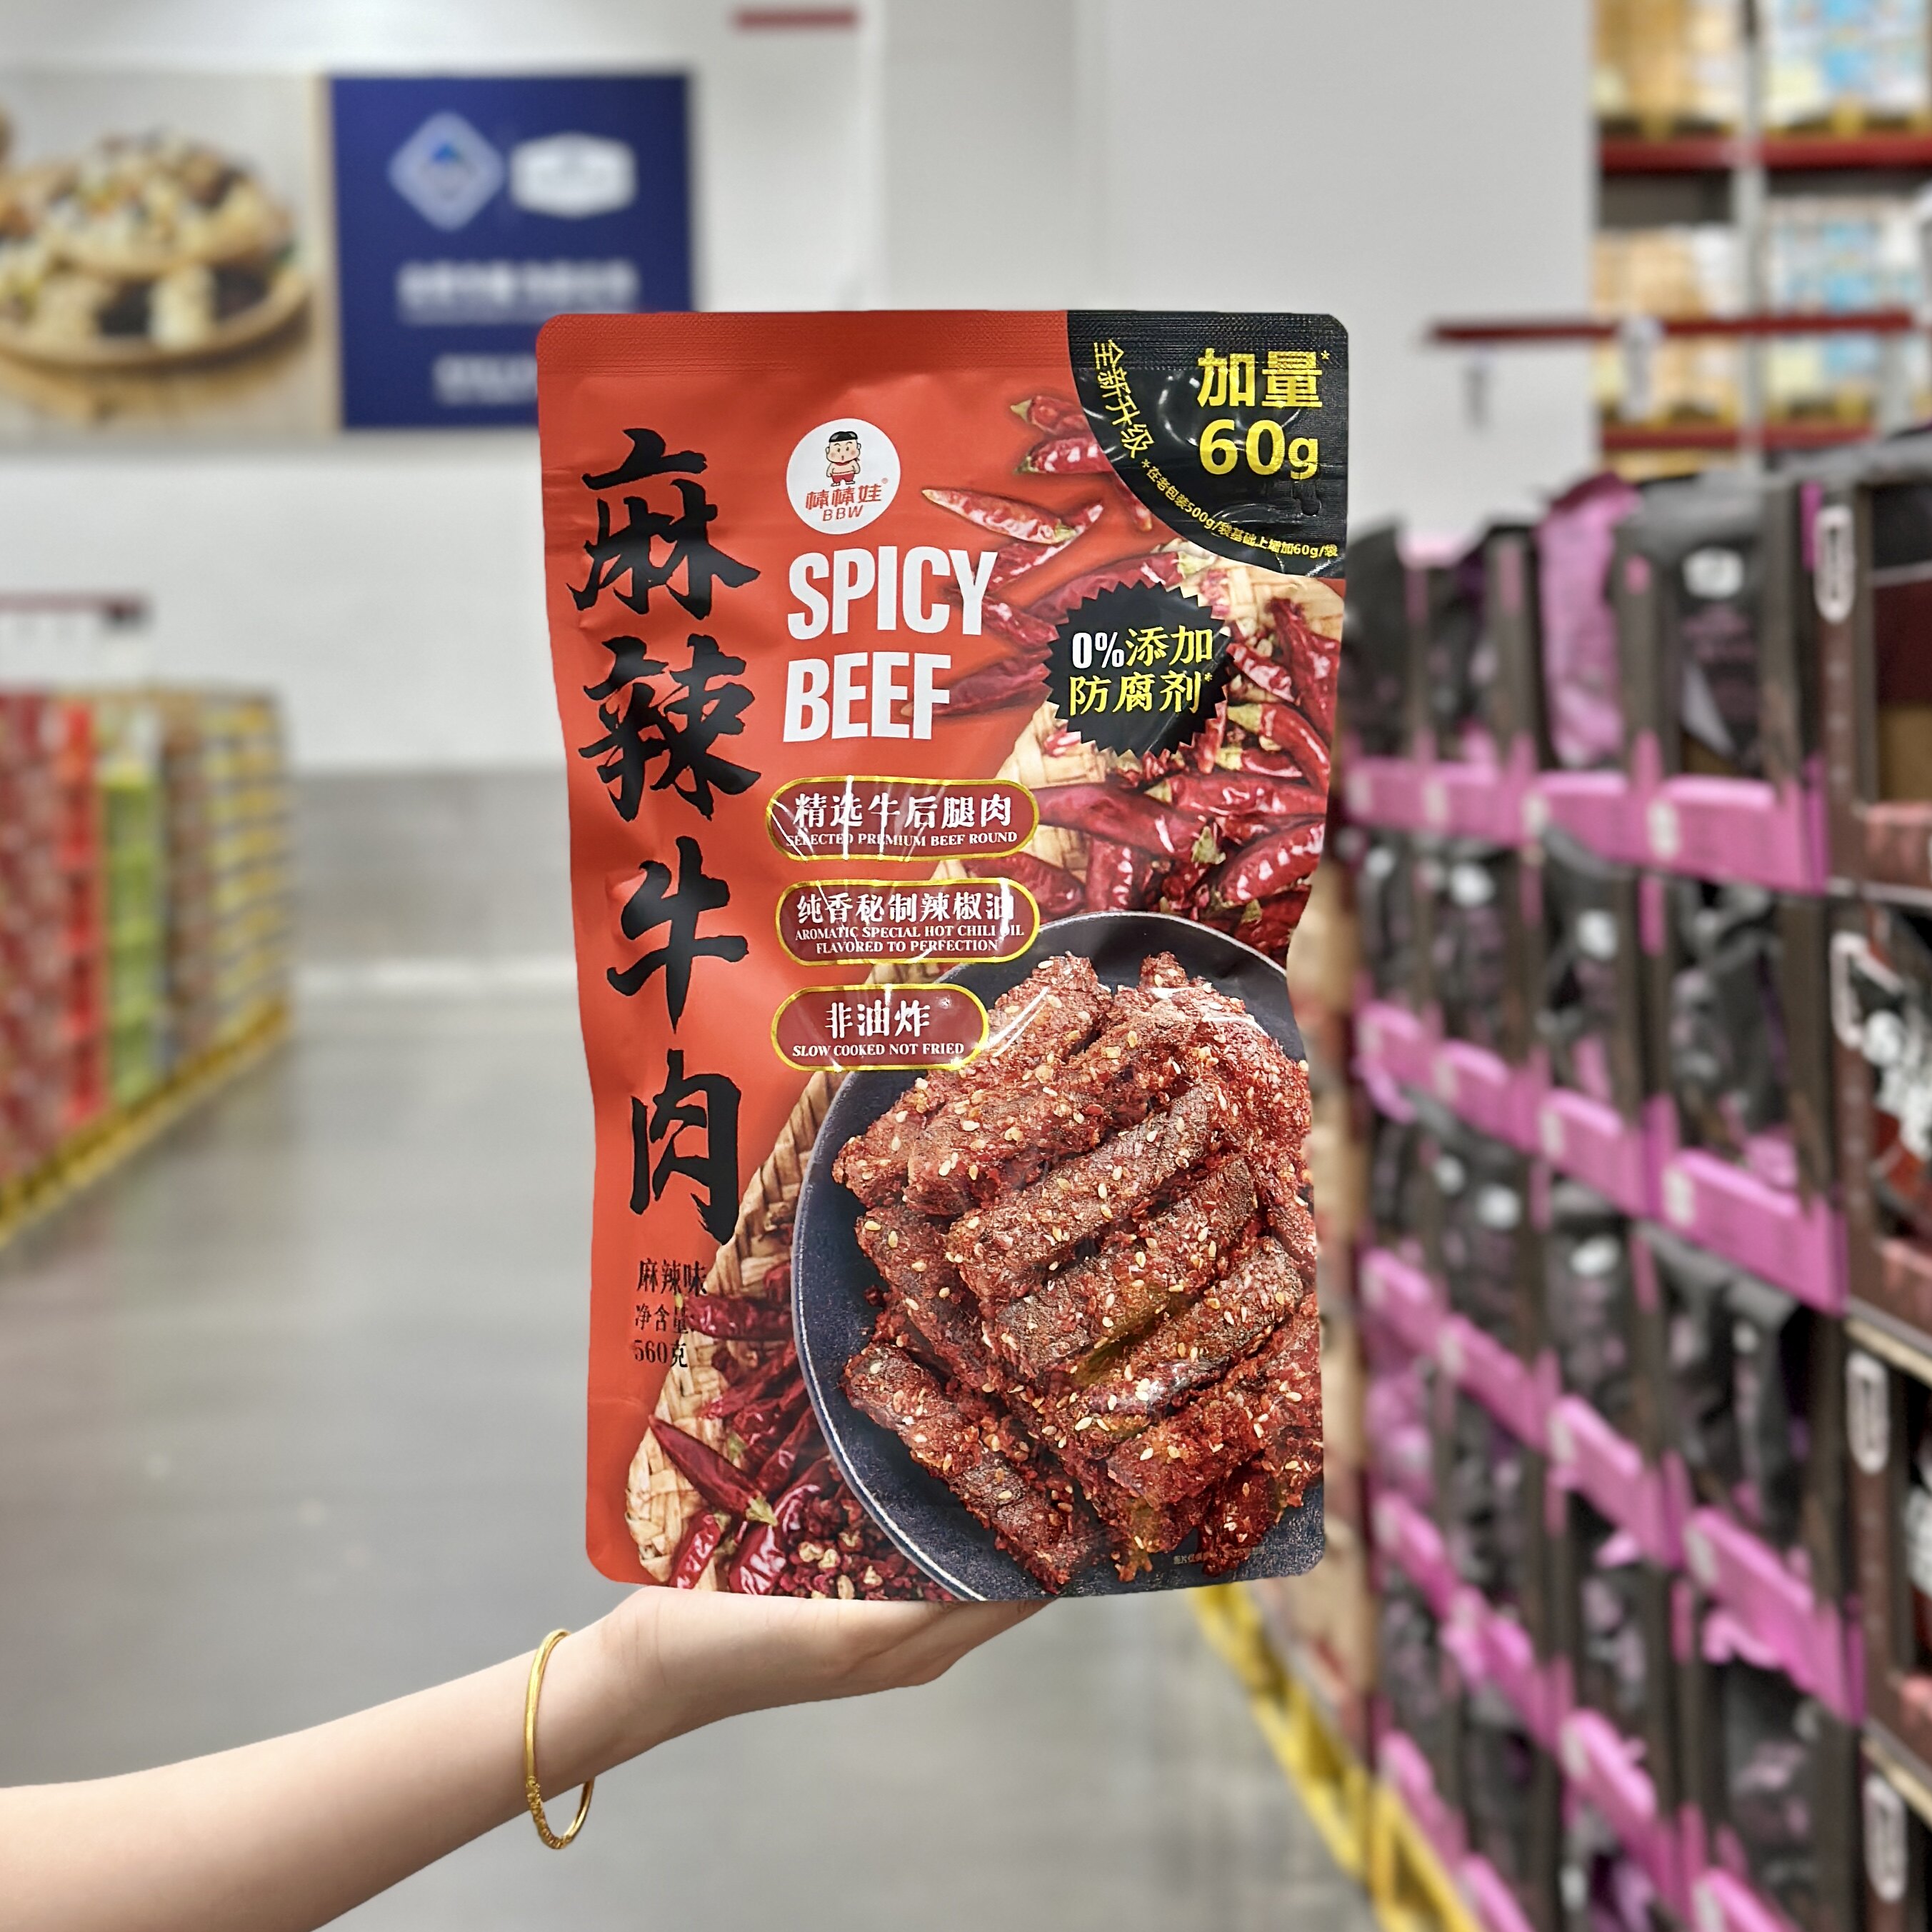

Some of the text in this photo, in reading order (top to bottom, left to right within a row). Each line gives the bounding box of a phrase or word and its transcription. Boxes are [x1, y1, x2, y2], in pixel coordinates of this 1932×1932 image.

[1093, 339, 1154, 459] 全新升级
[1199, 419, 1319, 480] 60g
[822, 504, 864, 521] BBW
[787, 545, 998, 640] SPICY
[1072, 625, 1213, 669] 0%添加
[783, 651, 951, 742] BEEF
[793, 793, 1012, 829] 精选牛后腿肉
[566, 427, 761, 1246] 麻辣牛肉
[858, 833, 926, 847] PREMIUM
[931, 834, 966, 846] BEEF
[969, 831, 1018, 844] ROUND
[796, 891, 1014, 924] 纯香秘制辣椒油
[795, 926, 859, 941] AROMATIC
[861, 926, 921, 938] SPECIAL
[924, 925, 955, 937] HOT
[957, 925, 996, 936] CHILI
[816, 939, 998, 954] FLAVORED TO PERFECTION
[825, 999, 931, 1038] 非油炸
[792, 1042, 964, 1057] SLOW COOKED NOT FRIED
[637, 1258, 707, 1297] 麻辣味
[634, 1339, 688, 1368] 560克
